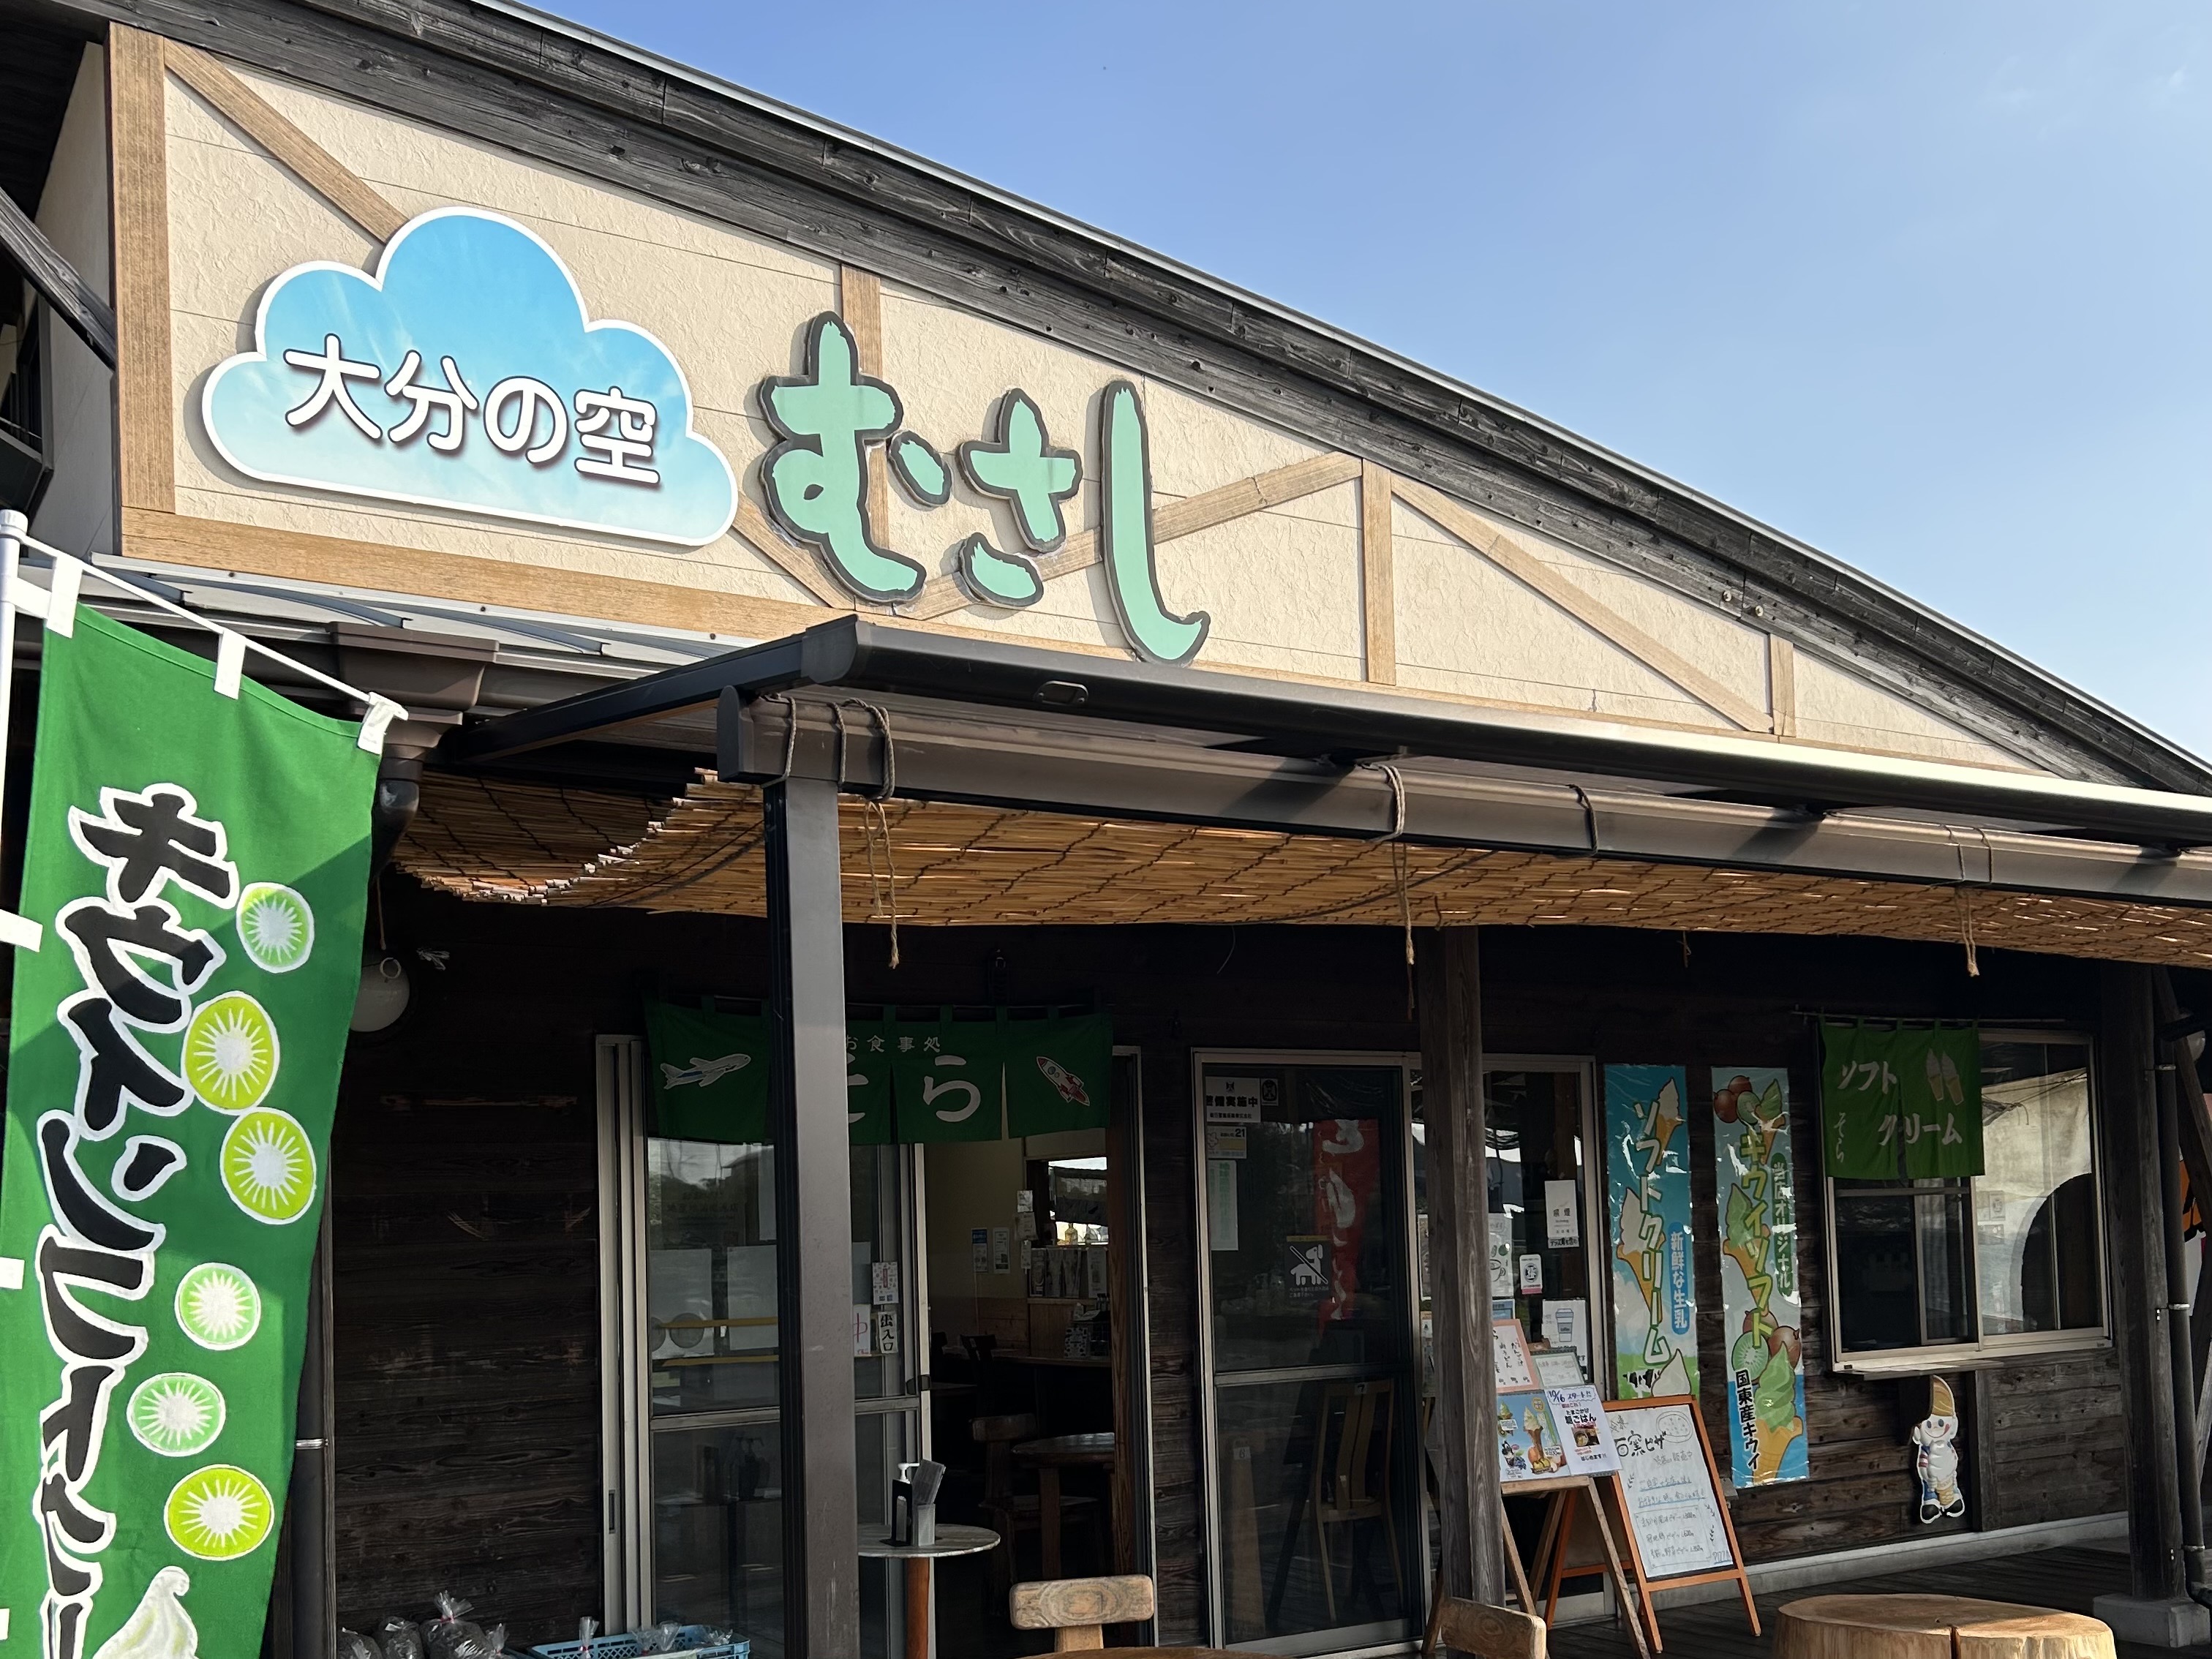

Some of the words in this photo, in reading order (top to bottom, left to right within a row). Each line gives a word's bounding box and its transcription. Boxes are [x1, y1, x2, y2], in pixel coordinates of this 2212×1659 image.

[283, 333, 661, 485] 大分の空
[759, 311, 1209, 665] むさし
[846, 1034, 941, 1053] お食事処
[1837, 1058, 1900, 1095] ソフト
[1234, 1129, 1246, 1137] 21
[1833, 1111, 1846, 1164] そら
[1876, 1113, 1963, 1147] クリーム
[1633, 1099, 1671, 1365] ソフトクリーム
[1739, 1129, 1776, 1349] キウイソフト
[1670, 1232, 1689, 1330] 新鮮な生乳
[880, 1314, 895, 1351] 出入口
[1735, 1369, 1760, 1470] 国東産キウイ
